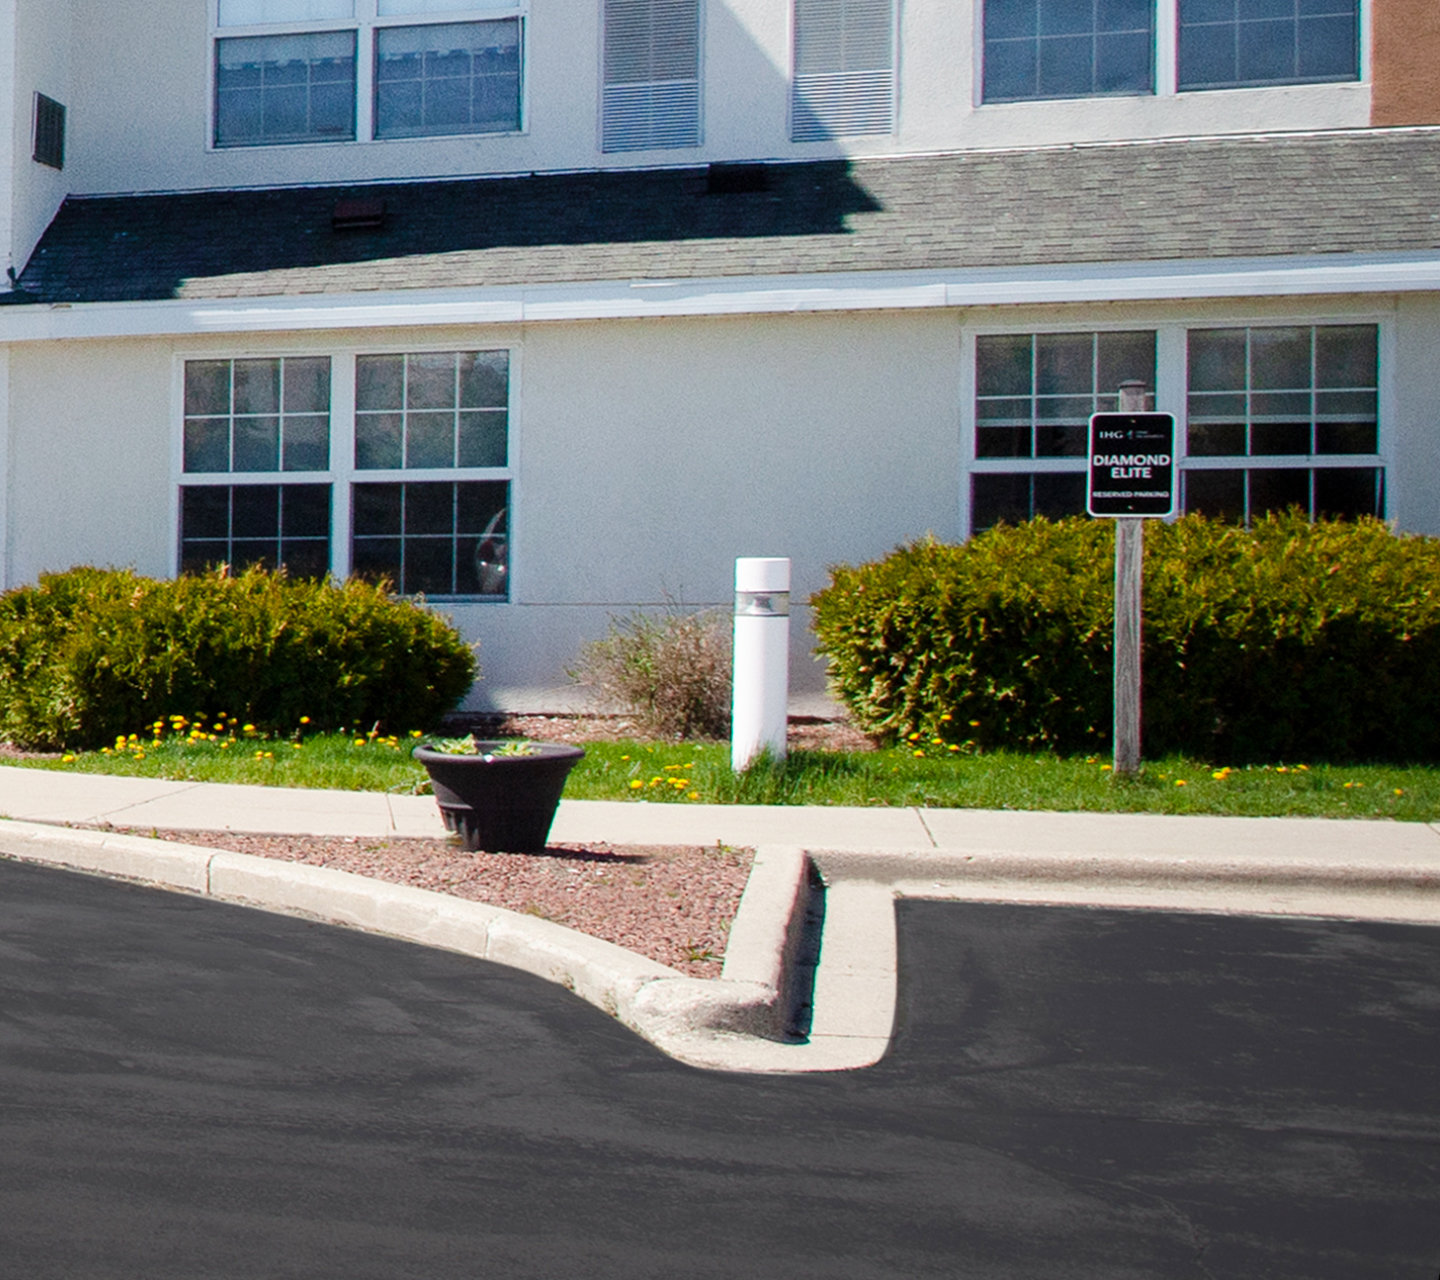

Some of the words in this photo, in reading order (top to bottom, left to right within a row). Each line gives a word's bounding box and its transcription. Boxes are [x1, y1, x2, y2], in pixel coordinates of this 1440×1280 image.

[1099, 430, 1123, 439] IHG
[1093, 454, 1170, 466] DIAMOND
[1111, 467, 1152, 479] ELITE
